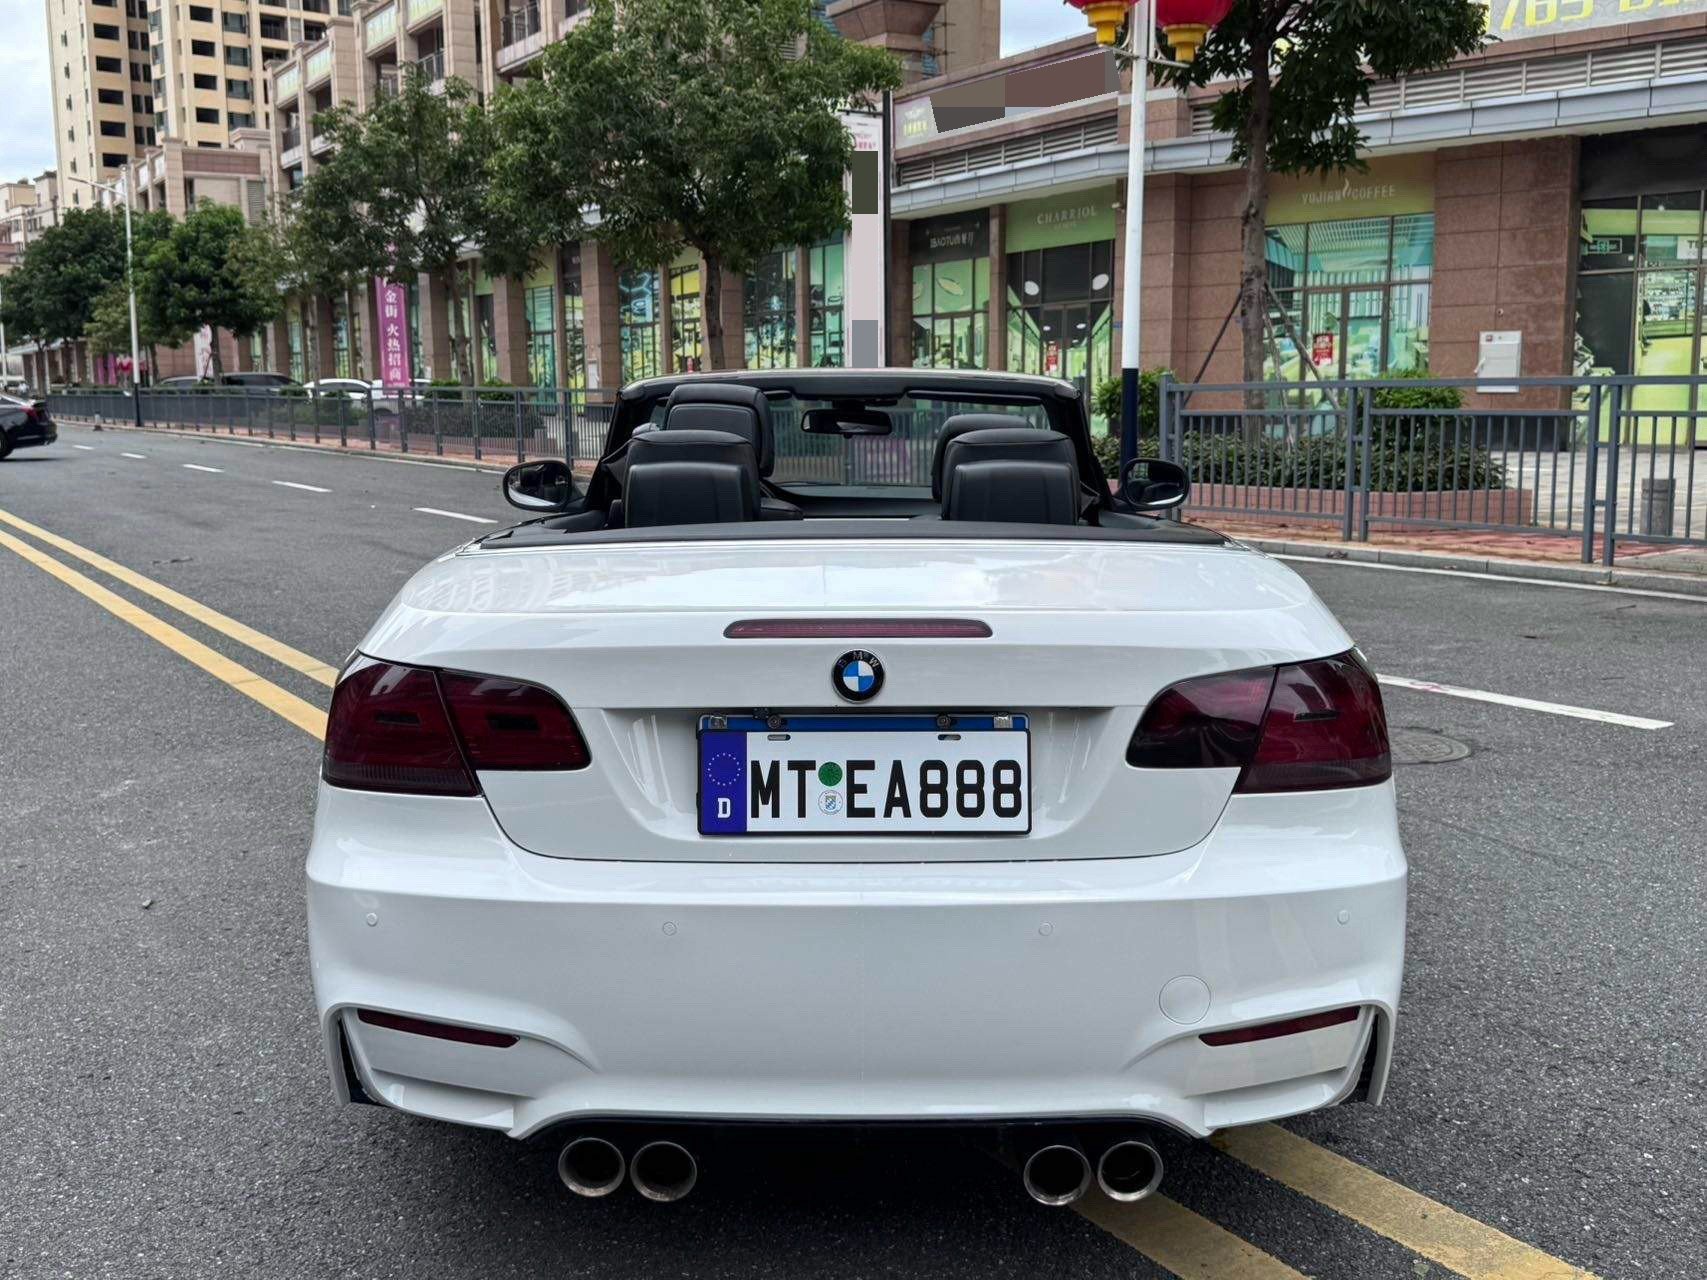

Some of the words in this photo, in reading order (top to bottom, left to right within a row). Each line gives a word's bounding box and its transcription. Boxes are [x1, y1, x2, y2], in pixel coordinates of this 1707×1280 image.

[1352, 184, 1396, 200] COFFEE
[1037, 205, 1097, 224] CHARRIOL
[385, 290, 398, 318] 金街
[837, 651, 880, 669] BMW
[750, 760, 817, 819] MT
[846, 760, 1022, 819] EA888
[717, 798, 731, 818] D
